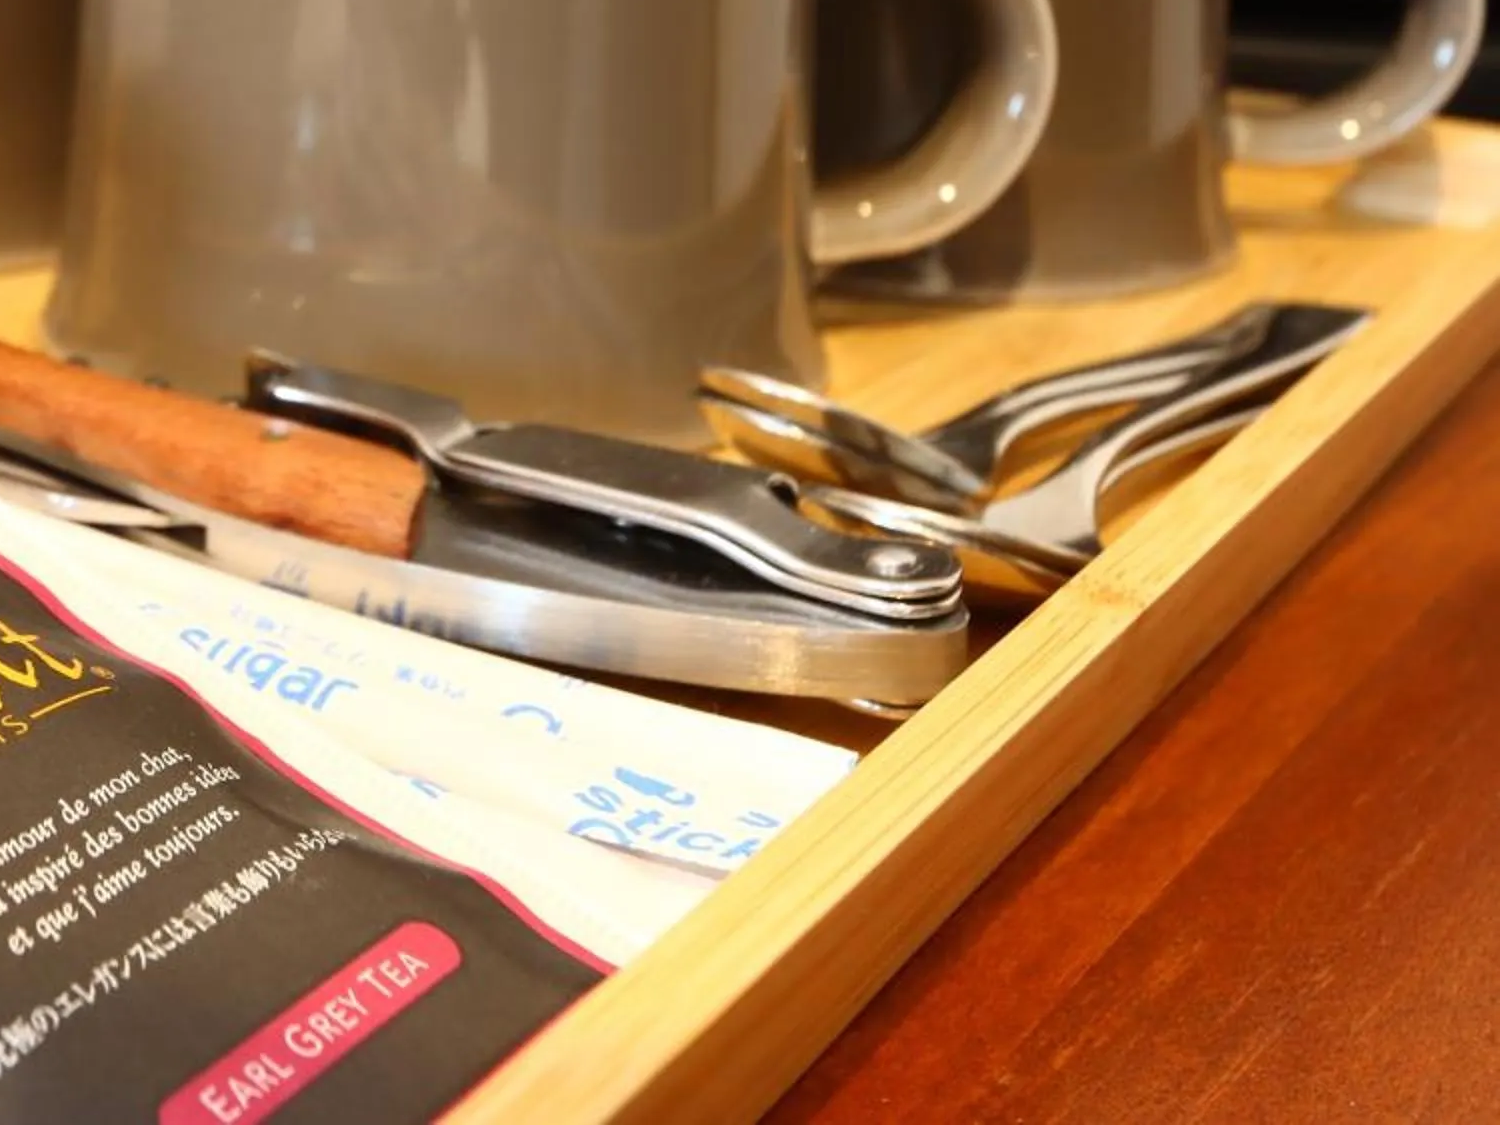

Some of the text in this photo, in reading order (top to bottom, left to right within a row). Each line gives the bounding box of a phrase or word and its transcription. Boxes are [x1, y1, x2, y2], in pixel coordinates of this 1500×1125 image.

[7, 843, 85, 906] inspiré
[82, 823, 123, 860] des
[115, 779, 198, 836] bonnes
[60, 796, 91, 826] de
[89, 767, 141, 809] mon
[141, 745, 193, 778] chat,
[7, 802, 242, 956] et que j'aime toujours.
[198, 950, 431, 1125] EARL GREY TEA
